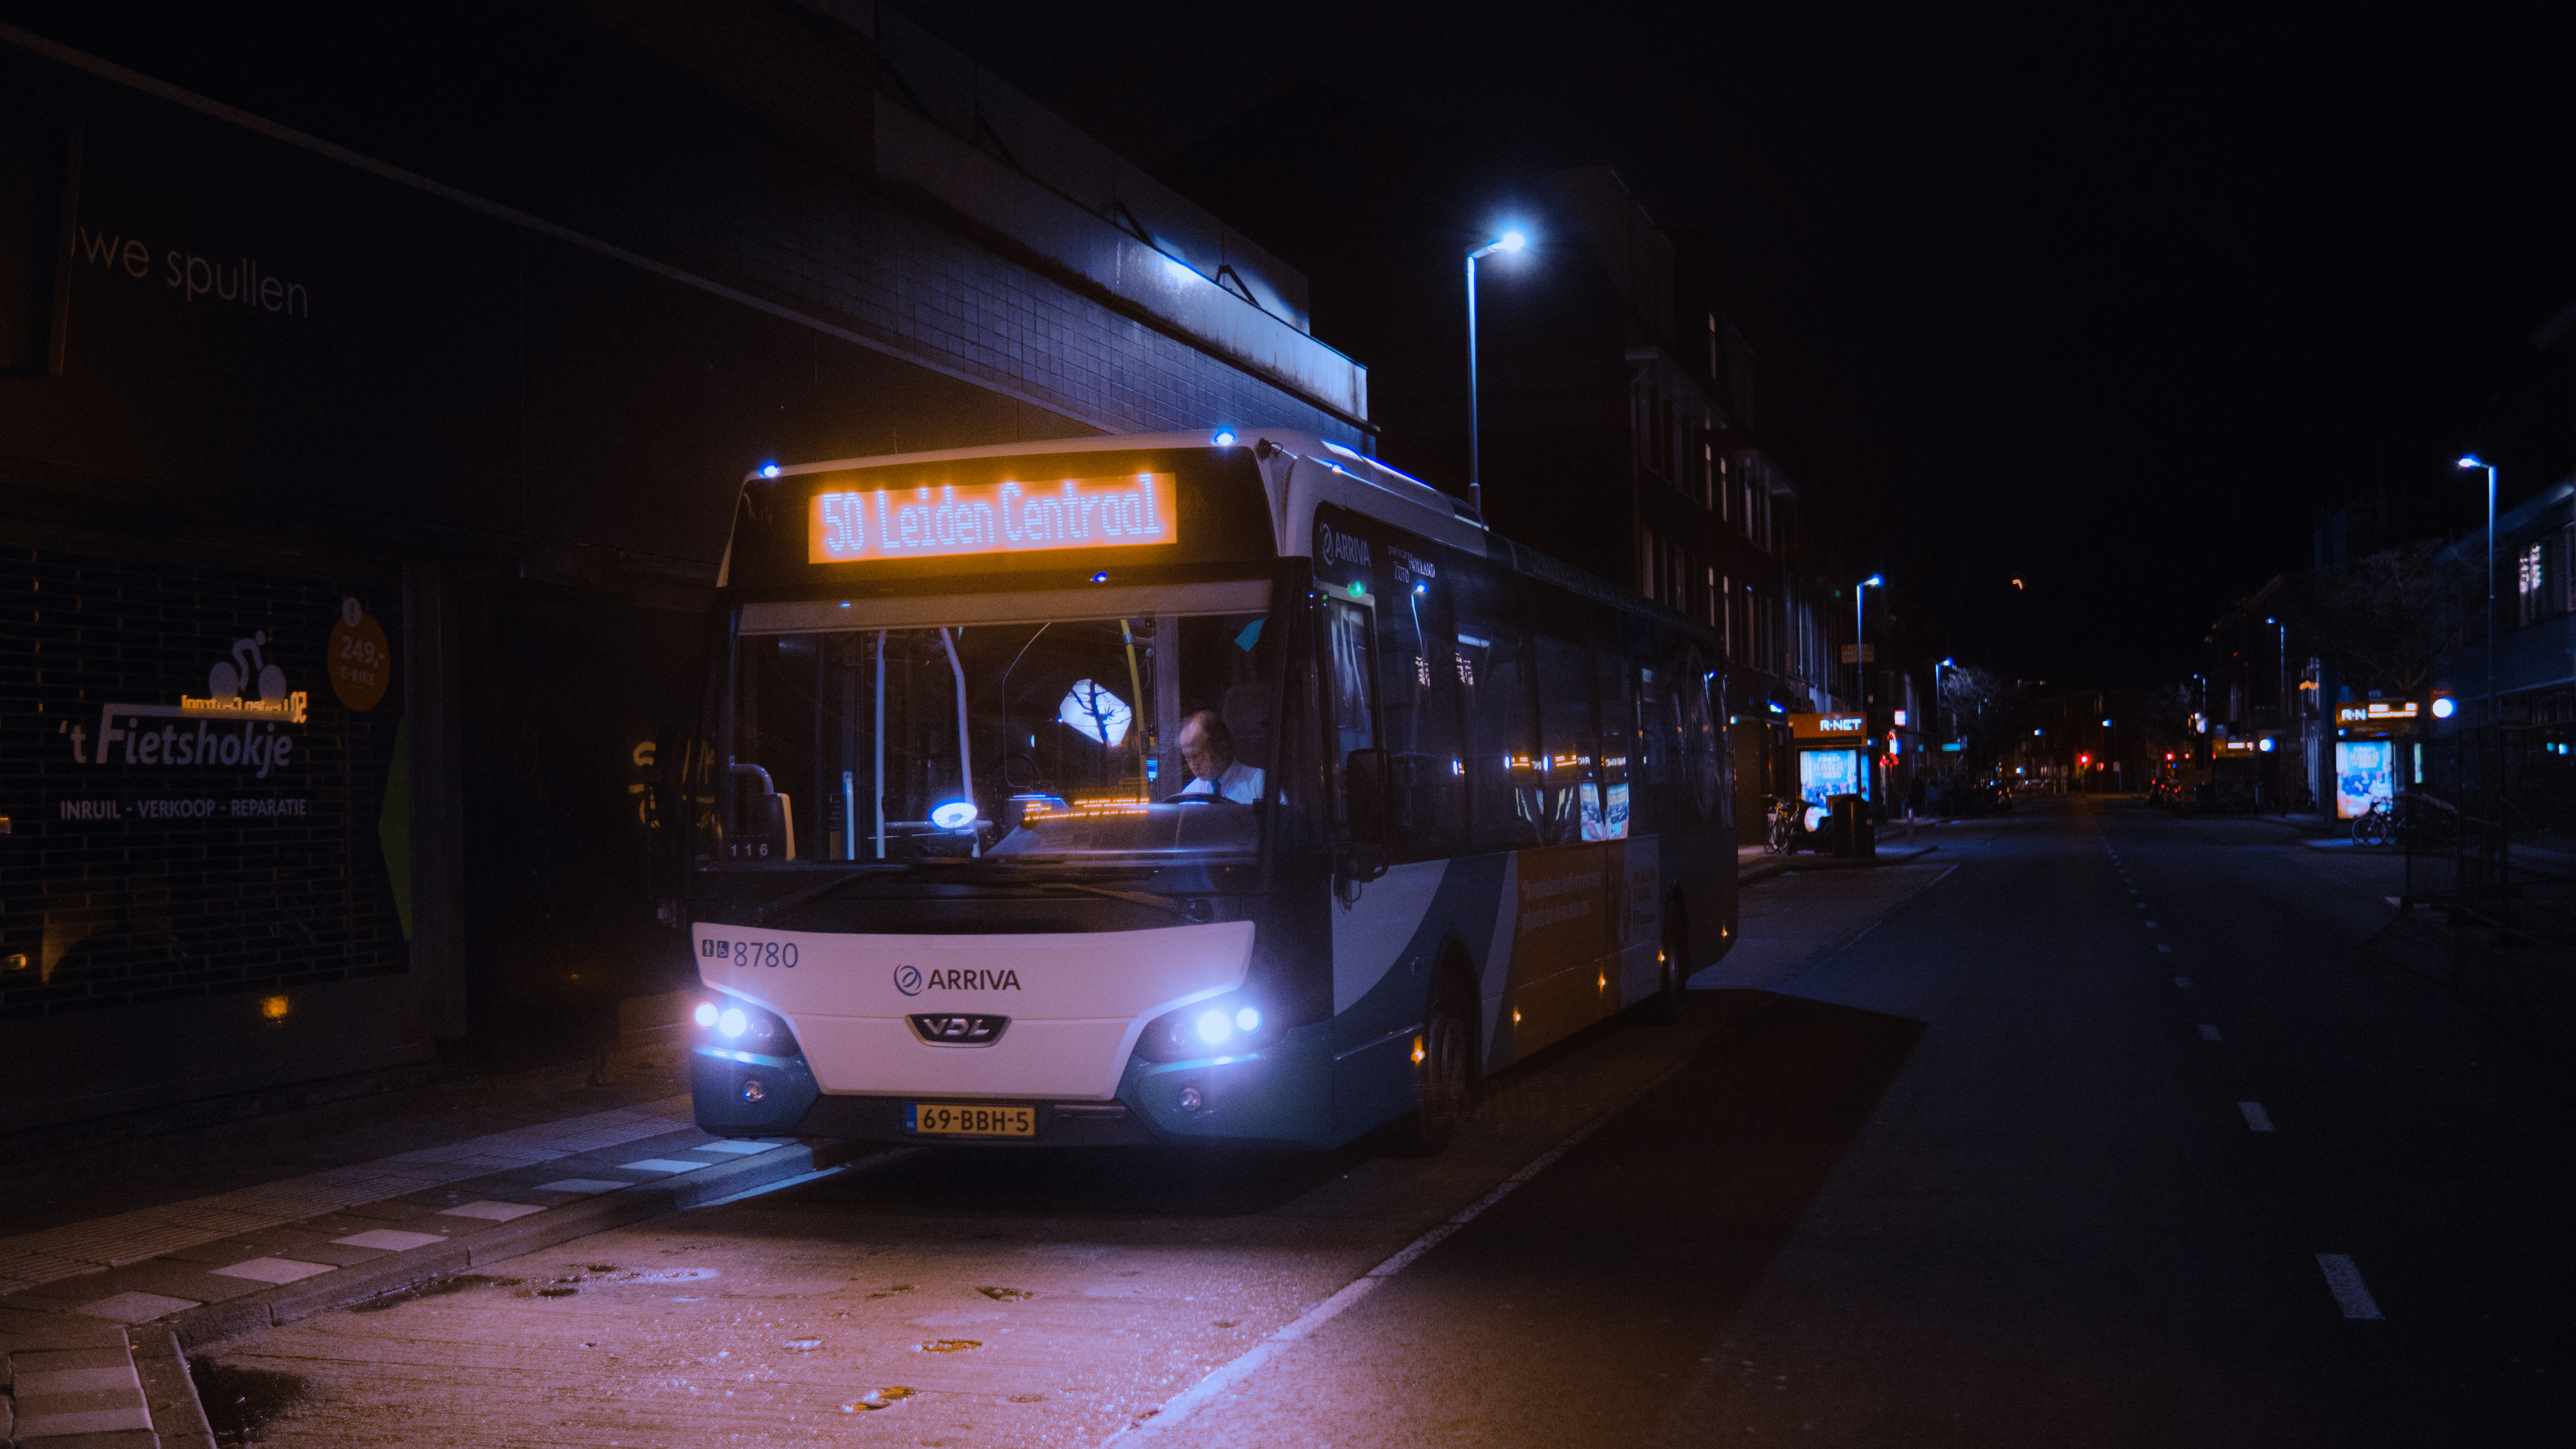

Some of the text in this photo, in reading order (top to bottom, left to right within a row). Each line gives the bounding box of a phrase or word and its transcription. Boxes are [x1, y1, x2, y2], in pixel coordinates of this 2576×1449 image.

[71, 225, 308, 319] we spullen
[824, 473, 1160, 552] 50 Leiden Centraal
[1335, 531, 1371, 568] ARRIVA
[1408, 552, 1435, 578] HOLLAND
[96, 703, 293, 779] Fietshokje
[61, 800, 121, 820] INRUIL
[137, 799, 216, 818] VERKOOP
[231, 798, 307, 816] REPARATIE
[733, 941, 800, 969] 8780
[927, 969, 1022, 992] ARRIVA
[923, 1018, 990, 1036] VDL
[922, 1107, 1030, 1133] 69-BBH-5
